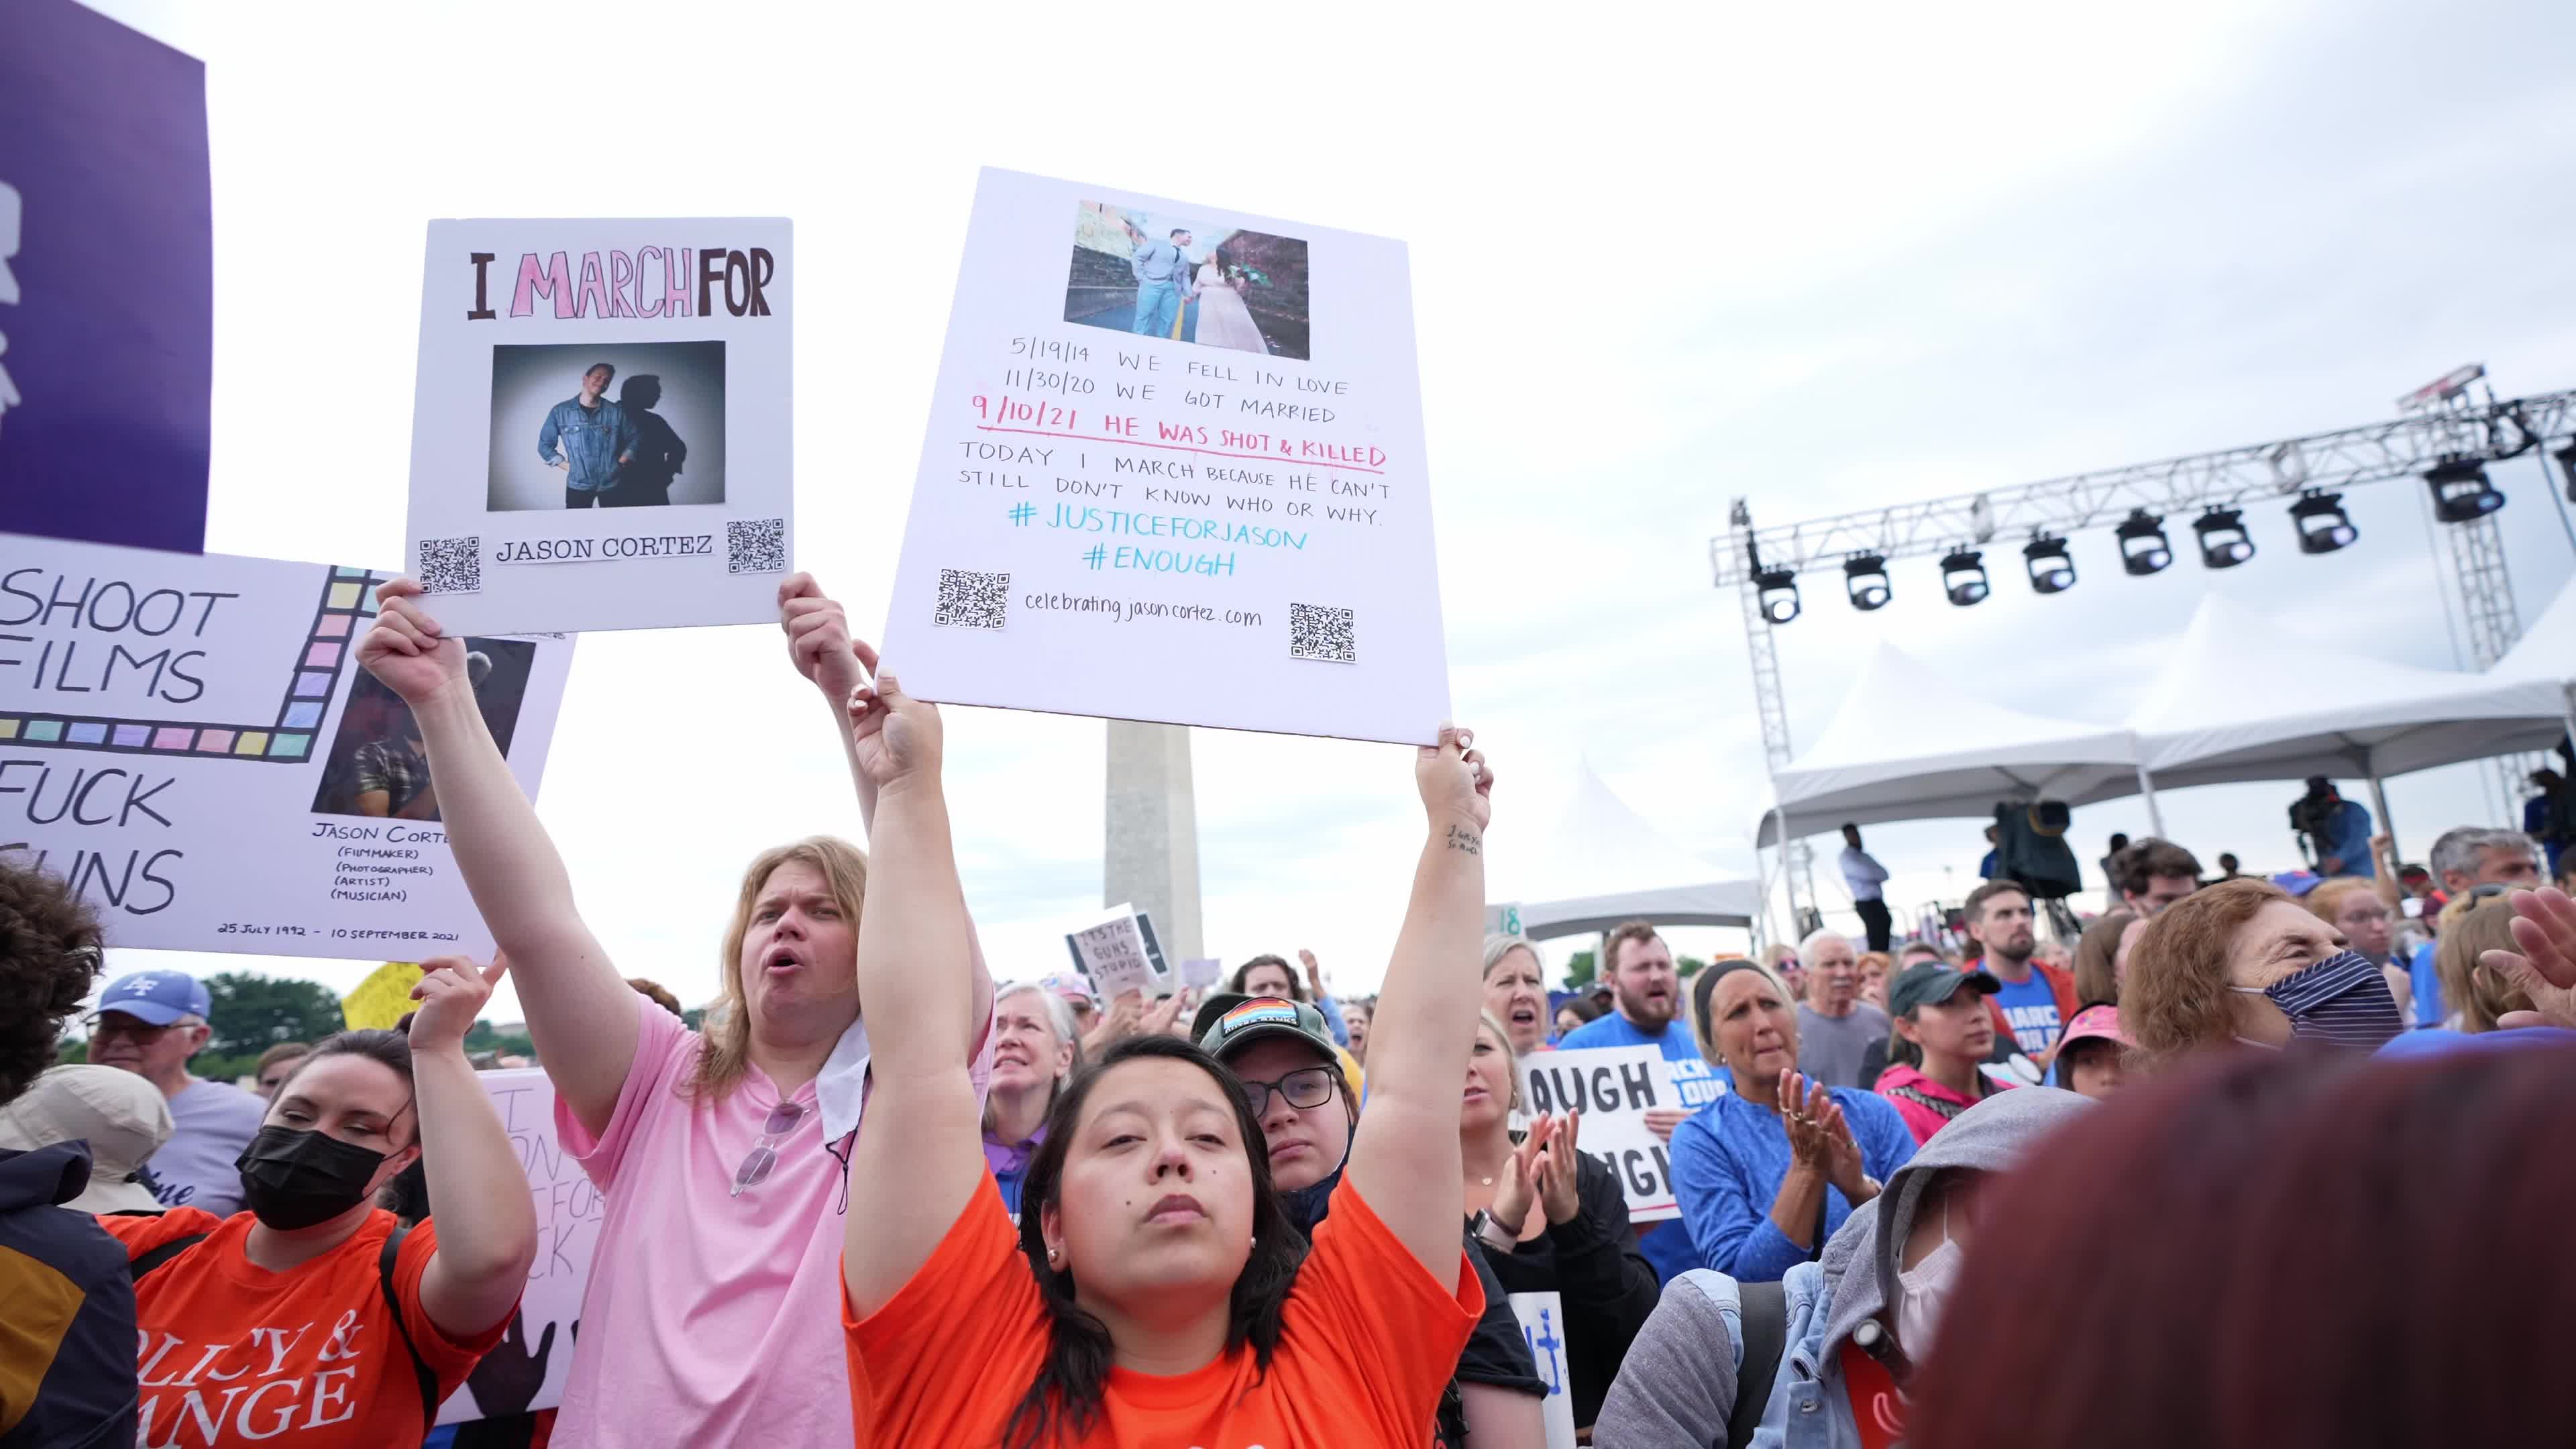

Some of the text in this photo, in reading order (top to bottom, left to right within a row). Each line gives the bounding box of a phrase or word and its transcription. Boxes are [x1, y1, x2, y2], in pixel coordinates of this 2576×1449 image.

[467, 246, 774, 321] I MARCH FOR
[1011, 337, 1350, 394] 5/19/14 WE FELL IN LOVE
[1006, 368, 1335, 423] 11/30/20 WE GOT MARRIED
[973, 396, 1386, 466] 9/10/21 HE WAS SHOT & KILLED
[959, 441, 1390, 499] TODAY I MARCH BECAUSE HE CAN'T
[959, 470, 1382, 526] STILL DON'T KNOW WHO OR WHY.
[496, 535, 713, 562] JASON CORTEZ
[0, 568, 240, 637] SHOOT
[0, 760, 175, 827] FUCK
[313, 822, 378, 840] JASON
[0, 843, 184, 915] UNS
[331, 889, 407, 902] (MUSICIAN)
[334, 875, 390, 887] (ARTIST)
[336, 861, 433, 876] (PHOTOGRAPHER)
[217, 923, 237, 934] 25
[240, 924, 271, 934] JULY
[276, 926, 307, 936] 1992
[331, 928, 347, 938] 10
[350, 929, 429, 940] SEPTEMBER
[431, 932, 460, 941] 2021
[317, 1309, 364, 1360] &
